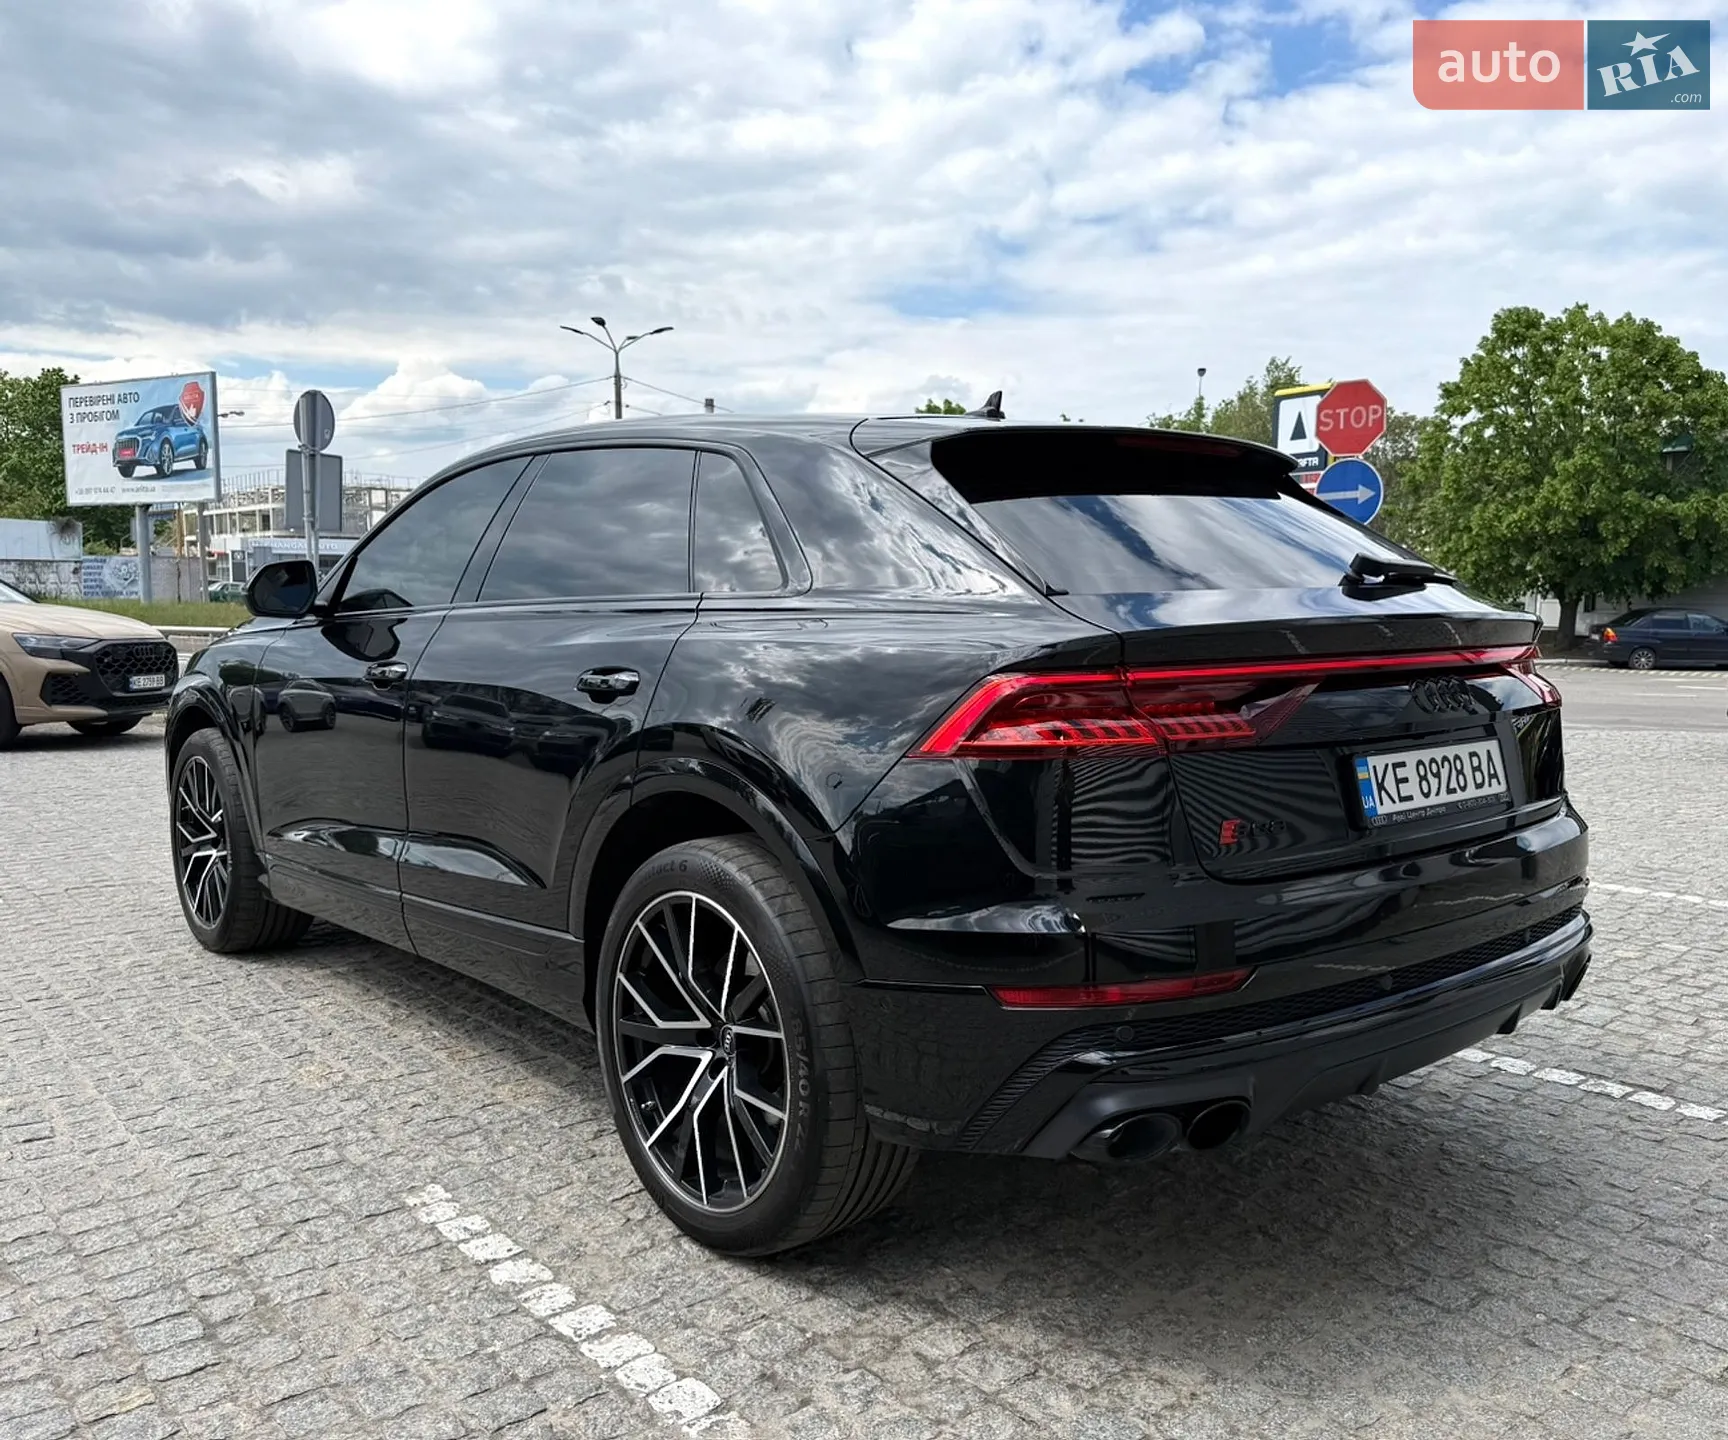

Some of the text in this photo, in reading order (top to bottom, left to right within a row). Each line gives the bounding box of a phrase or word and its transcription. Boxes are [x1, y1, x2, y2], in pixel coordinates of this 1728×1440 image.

[68, 392, 140, 408] ПЕРЕВІРЕНІ АВТО
[69, 410, 120, 423] З ПРОБІГОМ
[1319, 405, 1382, 431] STOP
[72, 441, 108, 455] ТРЕЙД-ІН
[1373, 749, 1501, 806] KE 8928 BA
[1362, 795, 1375, 809] UA
